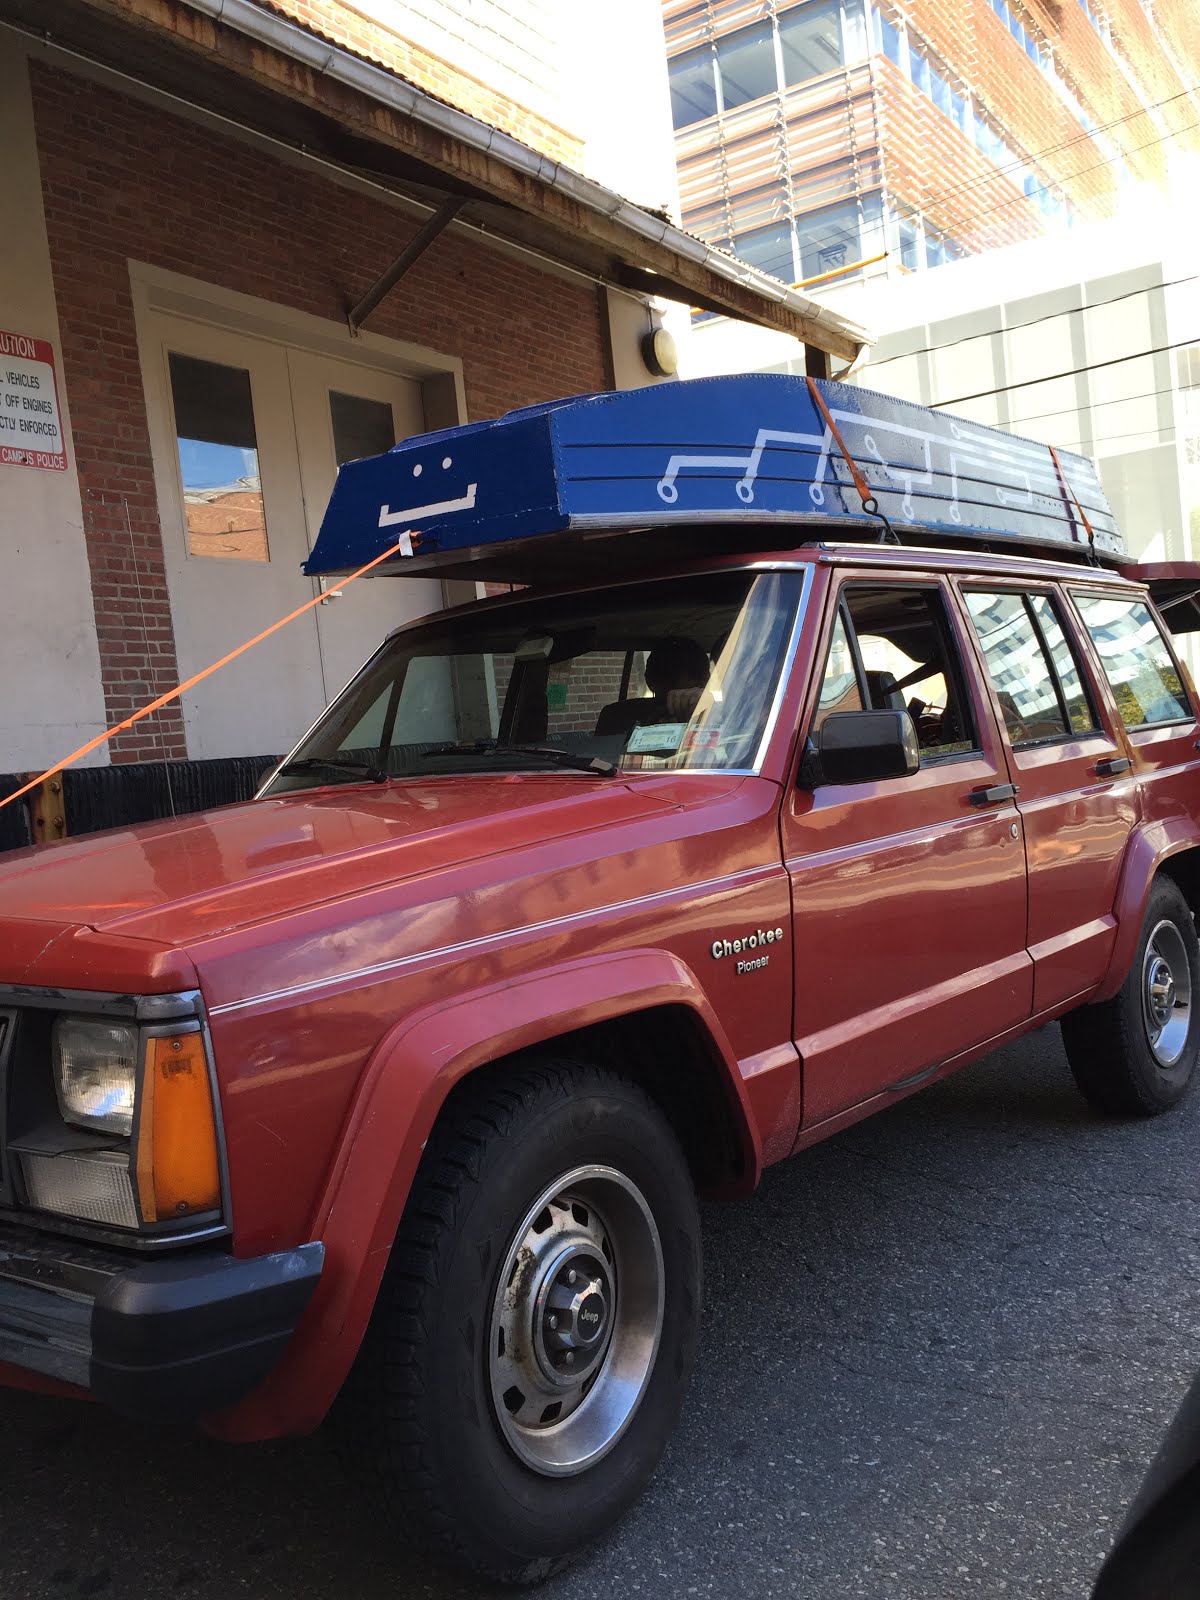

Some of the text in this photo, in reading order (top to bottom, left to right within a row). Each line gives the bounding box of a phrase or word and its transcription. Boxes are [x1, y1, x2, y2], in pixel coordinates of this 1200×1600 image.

[0, 333, 36, 358] UTION
[6, 371, 40, 390] VEHICLES
[5, 393, 20, 408] OFF
[23, 397, 53, 414] ENGINES
[19, 419, 58, 437] ENFORCED
[2, 448, 65, 469] CAMPUS POLICE
[711, 927, 784, 959] Cherokee
[736, 955, 770, 975] Pioneer
[581, 1309, 599, 1324] Jeep
